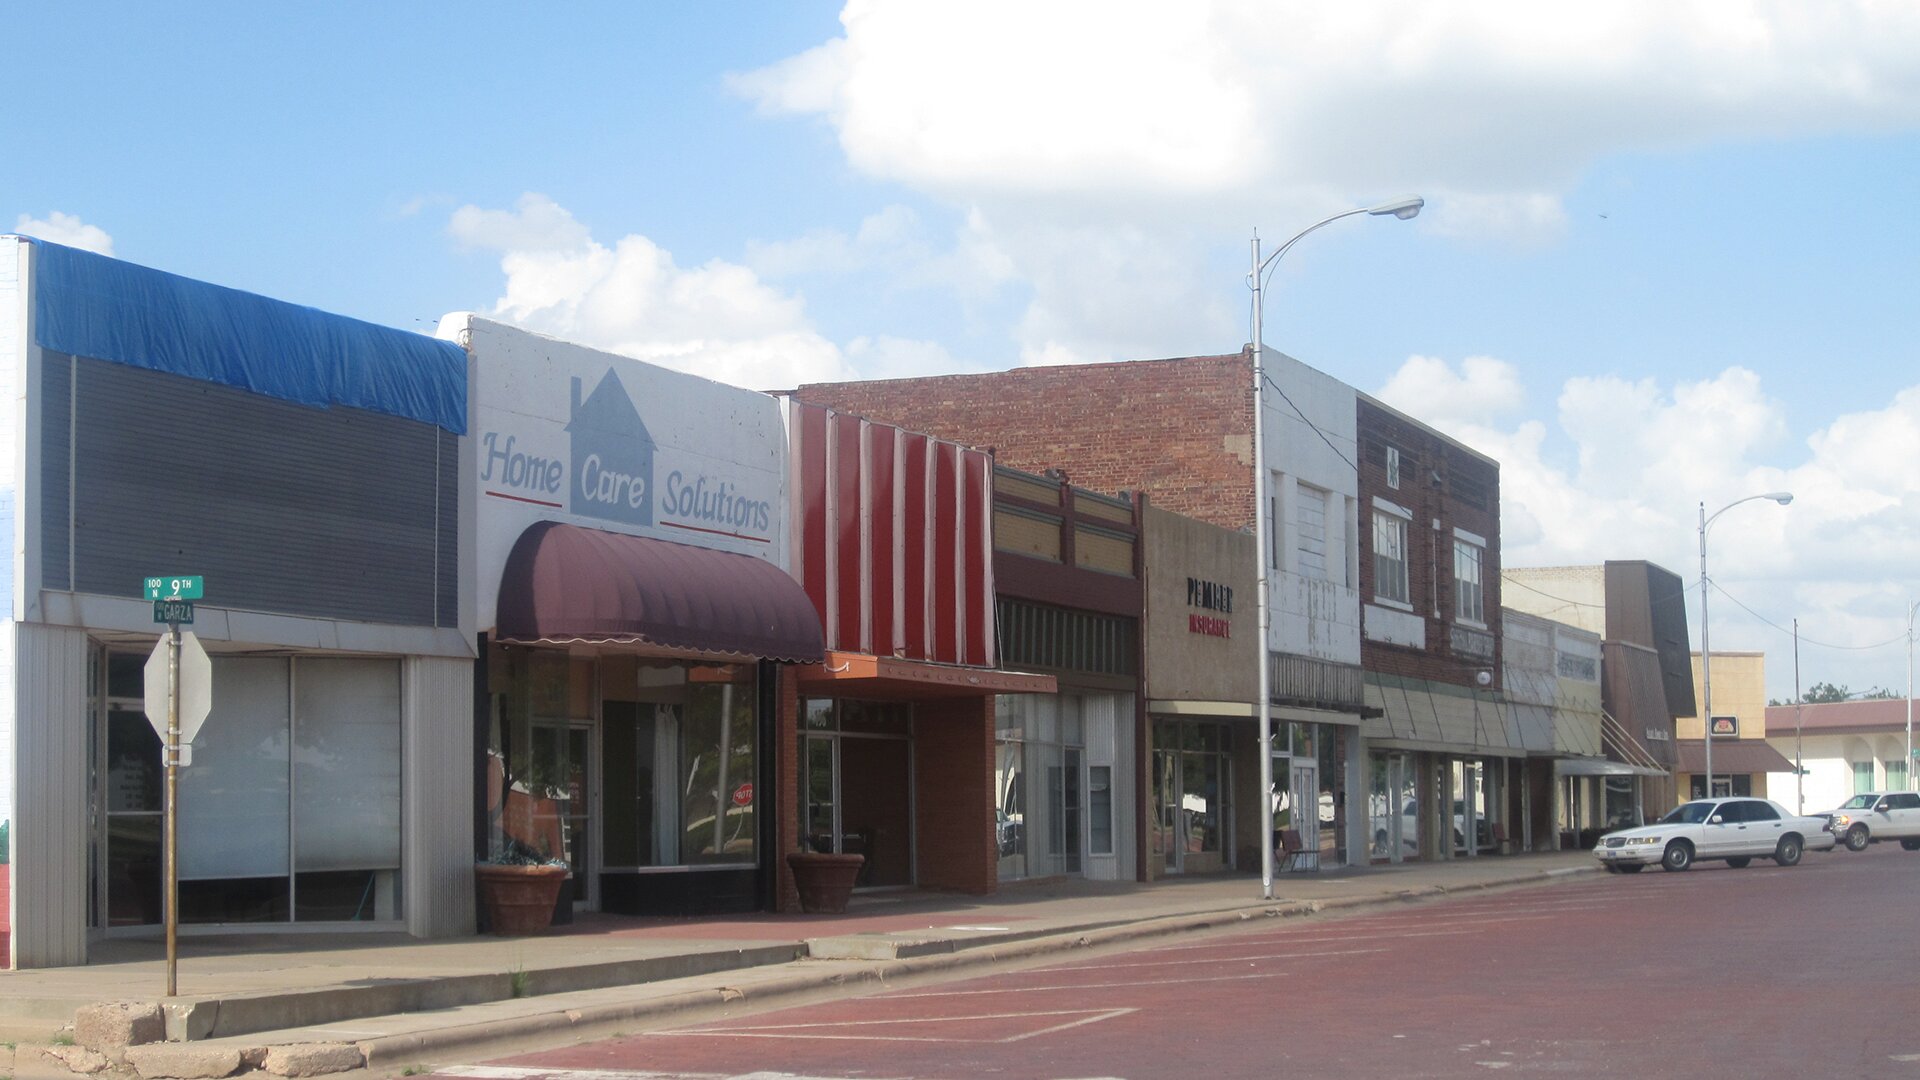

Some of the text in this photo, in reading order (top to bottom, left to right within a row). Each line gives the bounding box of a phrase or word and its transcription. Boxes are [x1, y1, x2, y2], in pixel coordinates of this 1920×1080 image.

[481, 432, 770, 532] Home Care Solutions
[148, 579, 162, 588] 100
[152, 589, 158, 598] N
[1187, 577, 1232, 613] PEMBER
[164, 604, 193, 621] GARZA
[1189, 613, 1231, 640] INSURANCE
